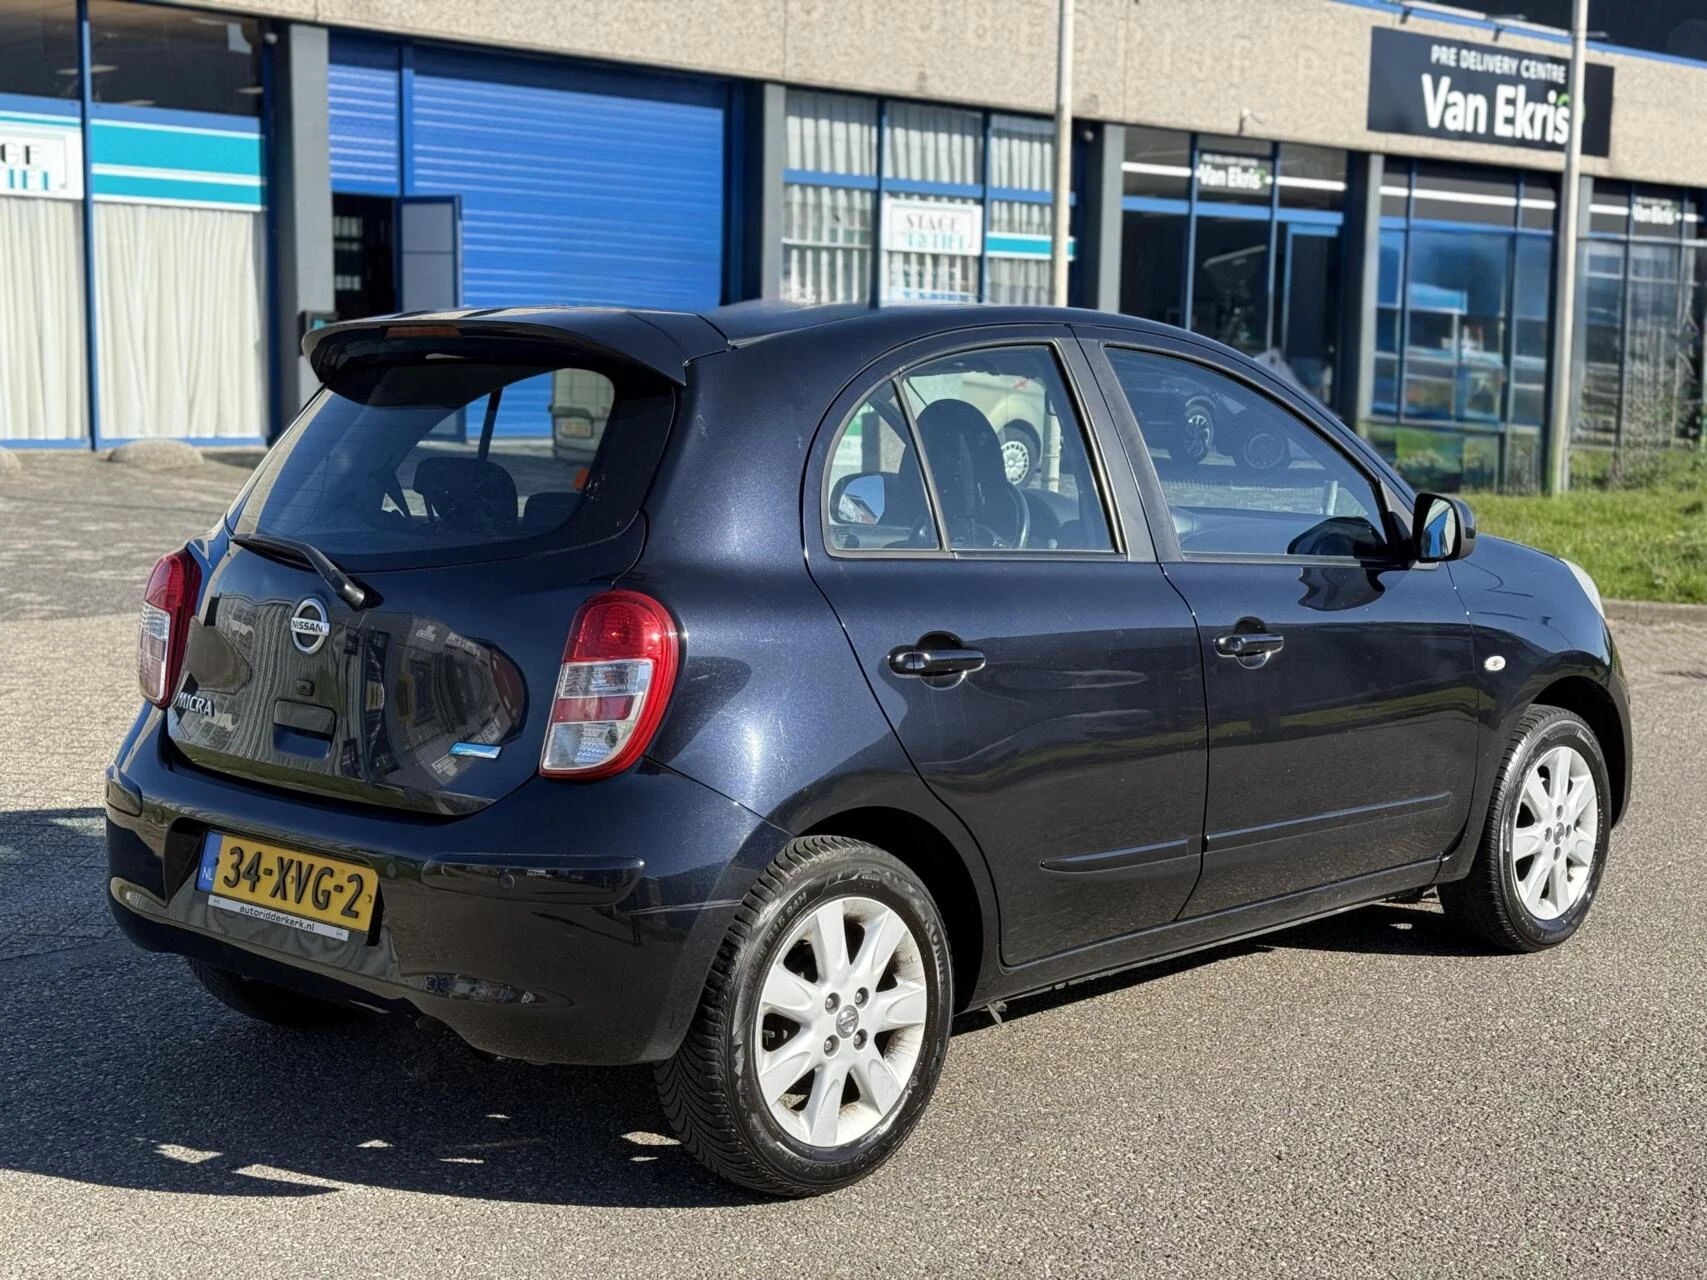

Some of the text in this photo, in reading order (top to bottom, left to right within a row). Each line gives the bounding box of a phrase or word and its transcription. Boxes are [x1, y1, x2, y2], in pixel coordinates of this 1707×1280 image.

[1431, 44, 1566, 84] PRE DELIVERY CENTRE
[1421, 73, 1570, 145] Van Ekris
[292, 619, 323, 633] NISSAN
[178, 692, 214, 717] MICRA
[202, 867, 213, 881] NL
[223, 846, 364, 919] 34-XVG-2
[239, 905, 315, 931] autoridderkerk.nl
